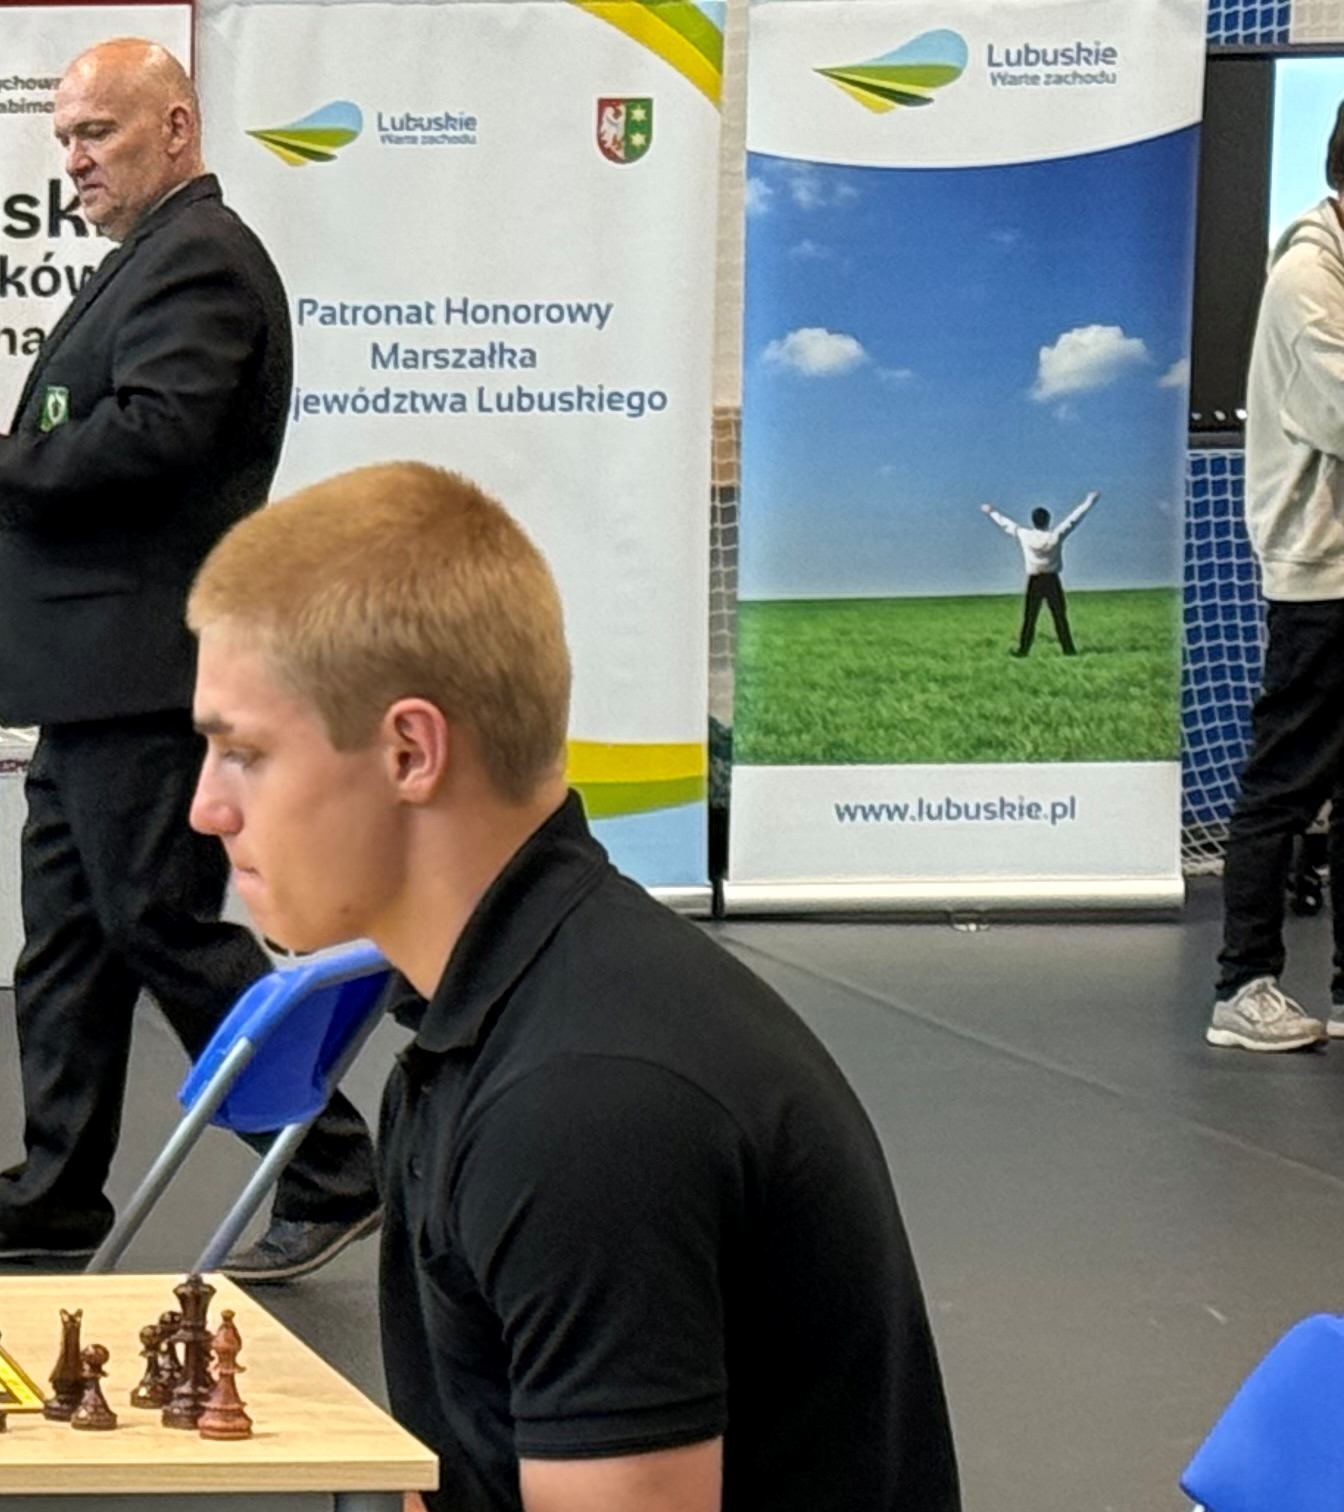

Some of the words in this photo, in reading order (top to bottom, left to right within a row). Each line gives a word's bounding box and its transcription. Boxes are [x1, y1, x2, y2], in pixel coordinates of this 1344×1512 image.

[987, 40, 1118, 68] Lubuskie
[989, 71, 1042, 87] Warte
[1042, 69, 1117, 87] zachodu
[376, 111, 478, 133] Lubuskie
[297, 297, 436, 327] Patronat
[444, 296, 614, 331] Honorowy
[370, 341, 537, 370] Marszałka
[293, 386, 468, 423] jewództwa
[477, 383, 668, 419] Lubuskiego
[834, 795, 1076, 826] www.lubuskie.pl
